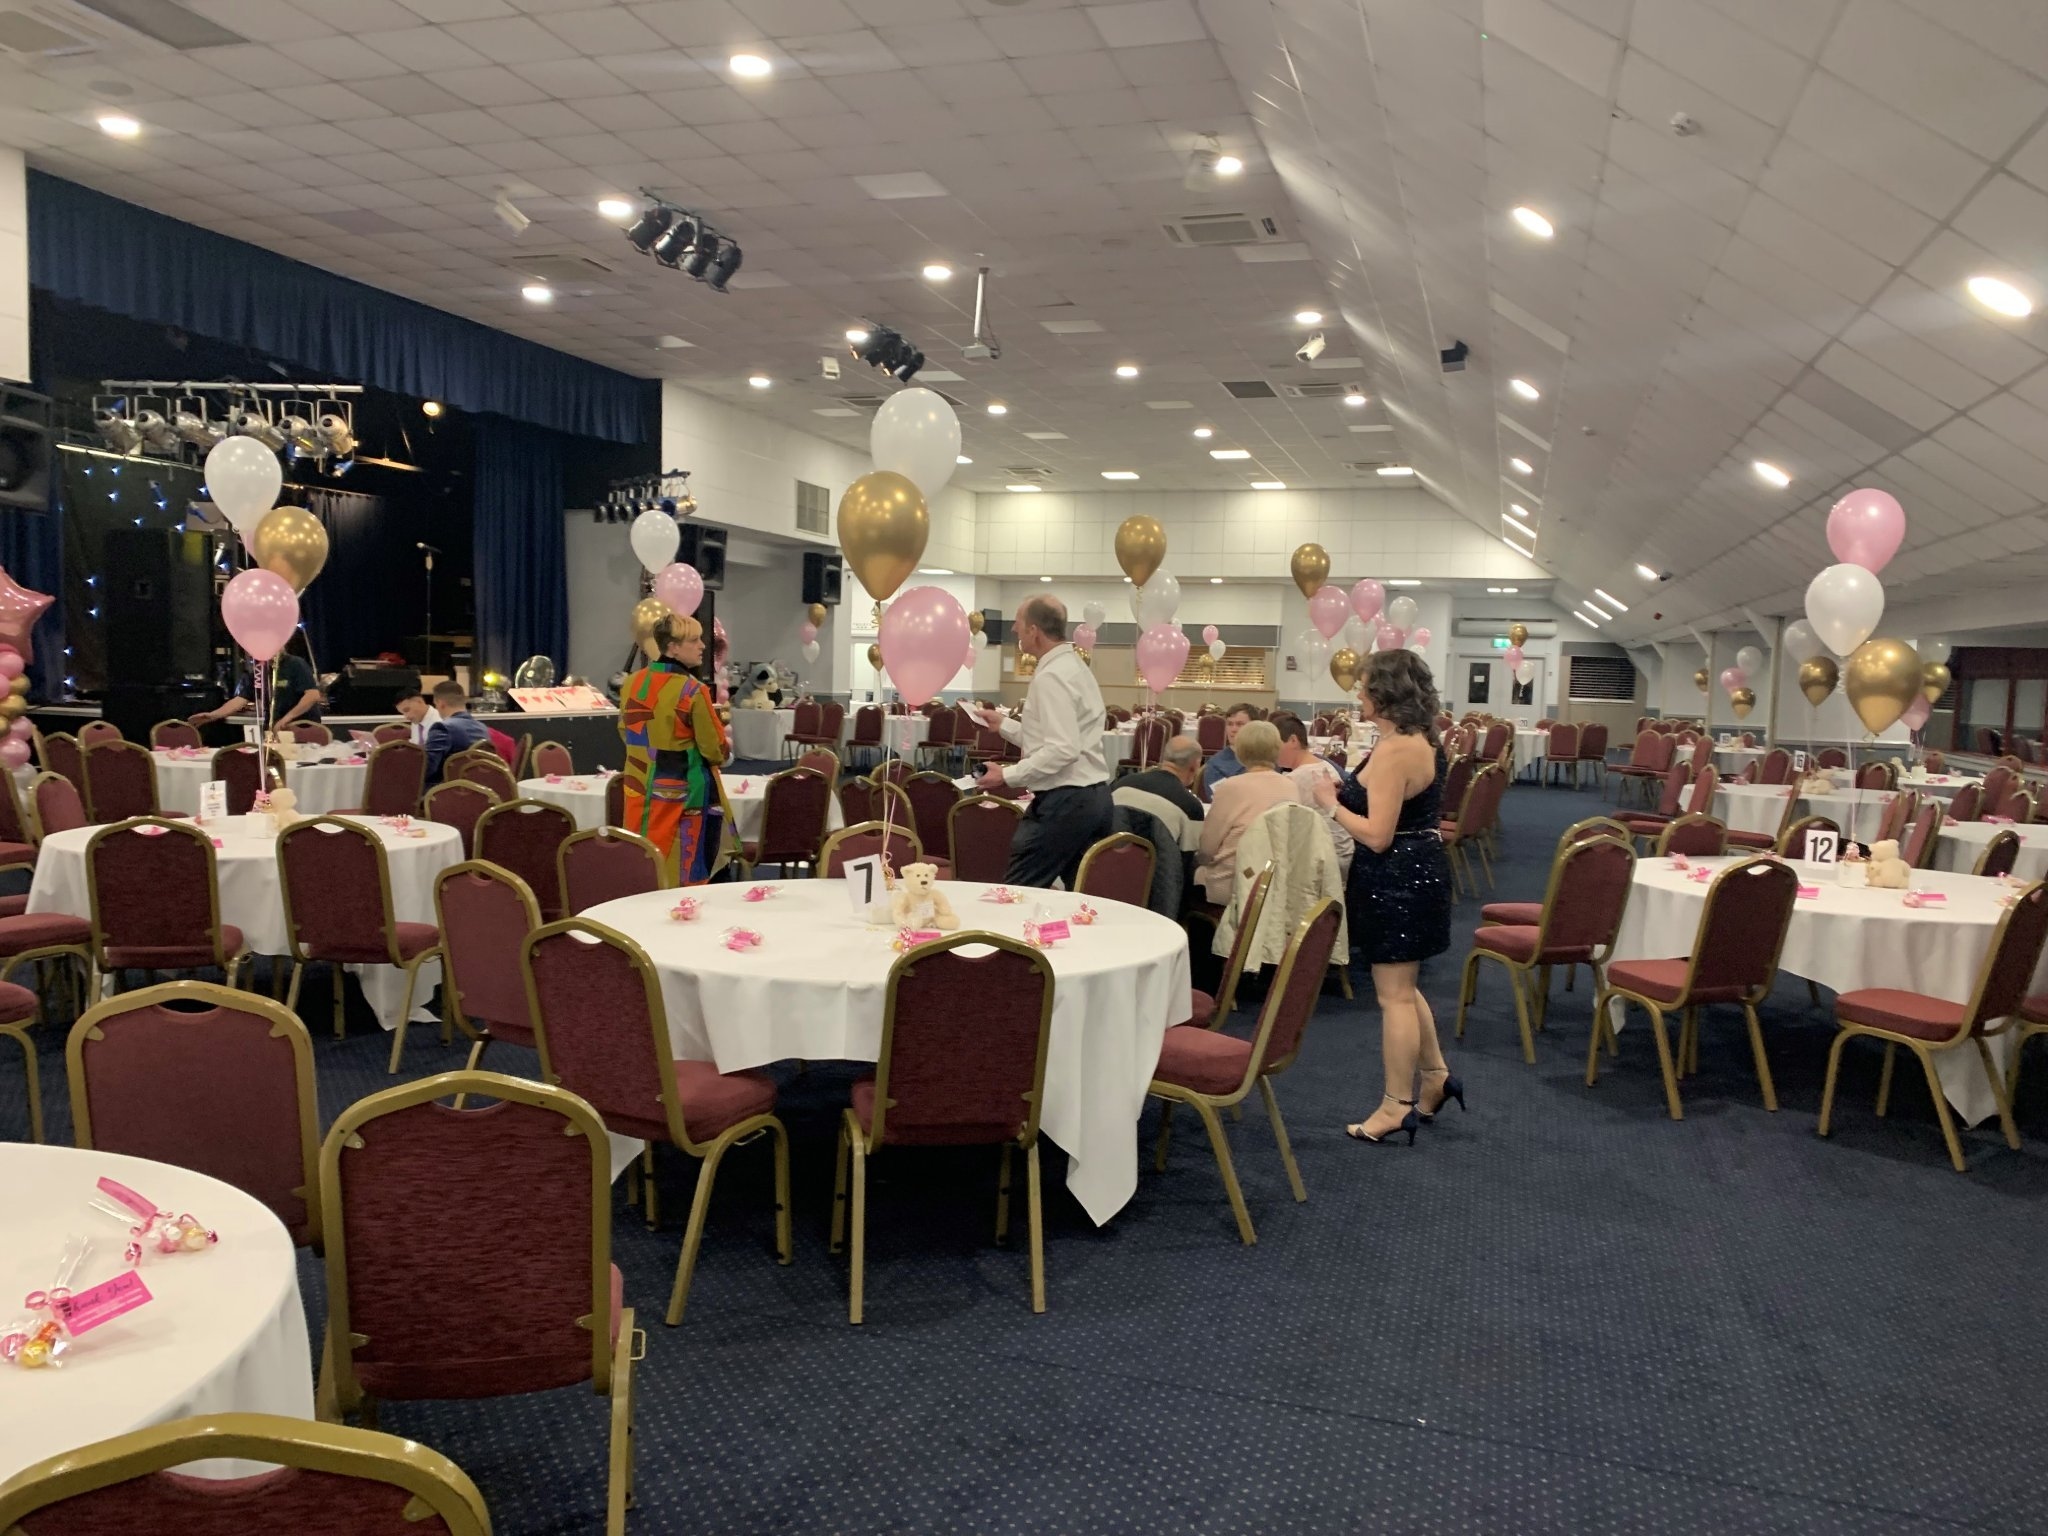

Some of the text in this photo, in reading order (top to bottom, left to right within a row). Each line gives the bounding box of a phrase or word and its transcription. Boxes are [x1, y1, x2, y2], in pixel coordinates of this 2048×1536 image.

[209, 782, 216, 791] 4
[1810, 836, 1833, 864] 12
[853, 861, 873, 904] 7
